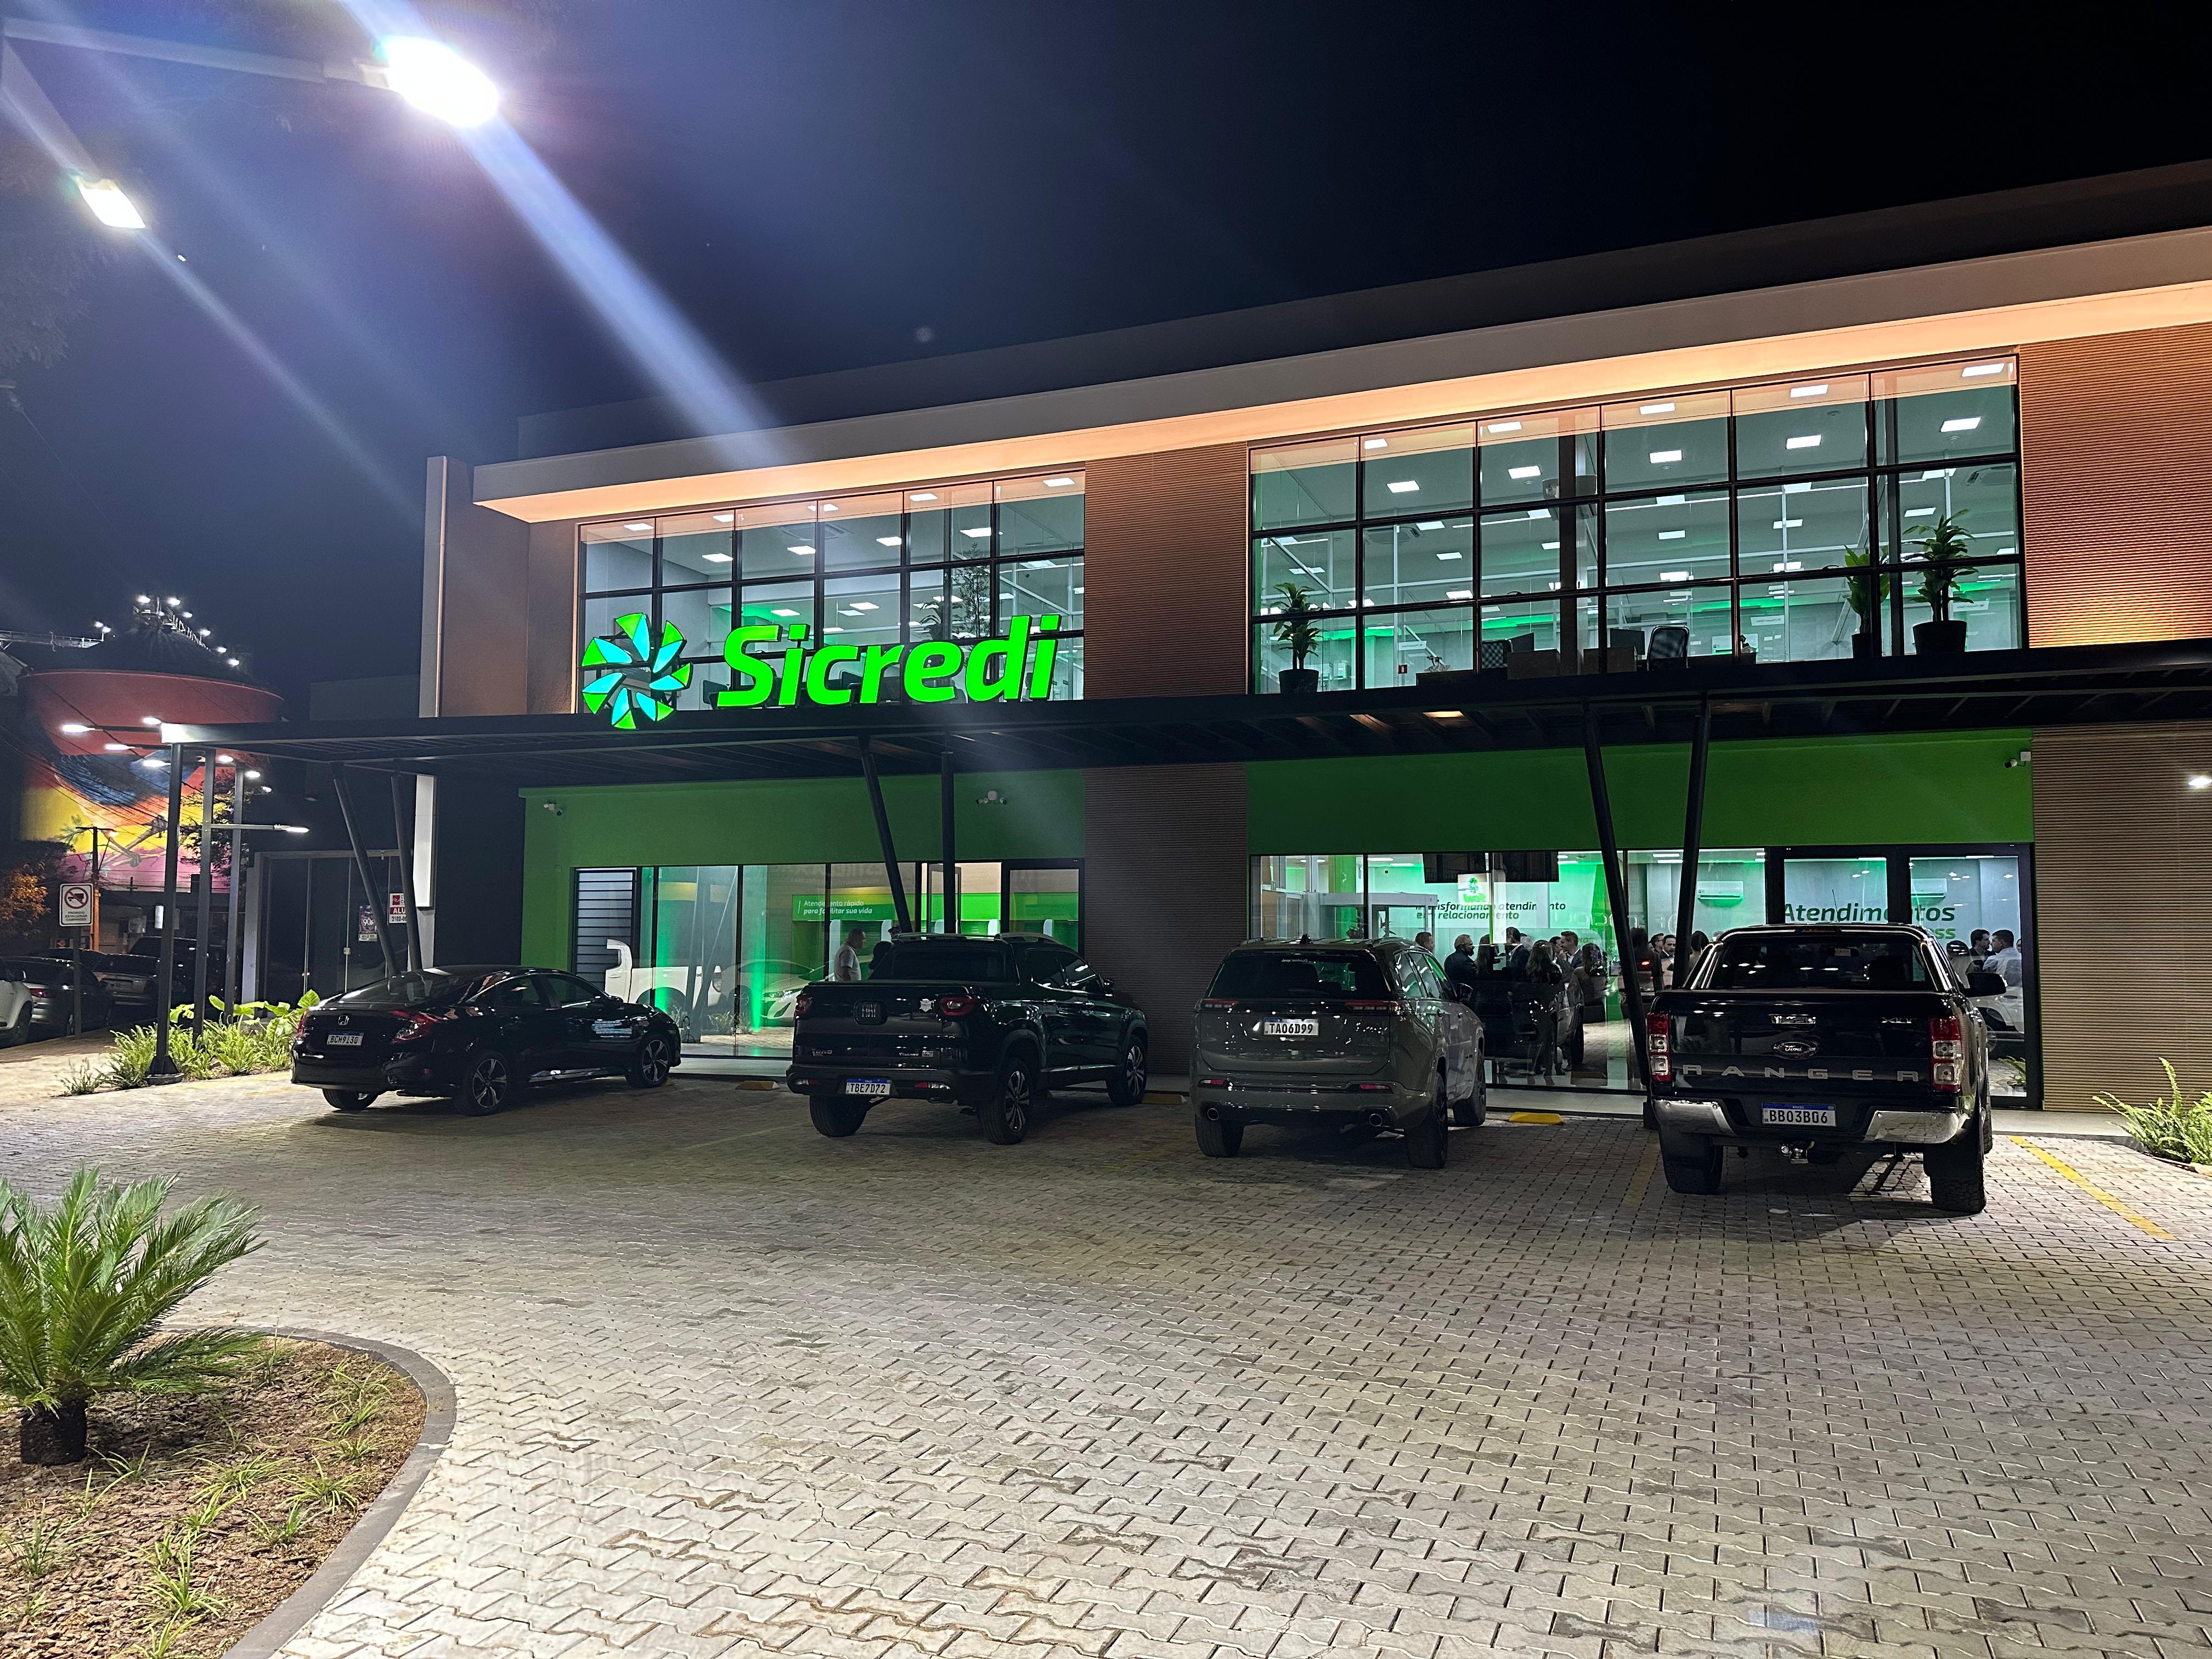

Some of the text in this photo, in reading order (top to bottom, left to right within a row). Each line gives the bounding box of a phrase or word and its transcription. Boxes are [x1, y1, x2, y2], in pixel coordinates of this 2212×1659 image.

[717, 614, 1062, 707] Sicredi
[1438, 911, 1520, 919] relacionaento
[1785, 902, 1955, 922] Atendimtos
[861, 1003, 877, 1018] FIAT
[1683, 1064, 1919, 1082] RANGER
[850, 1083, 886, 1093] TBE7D72
